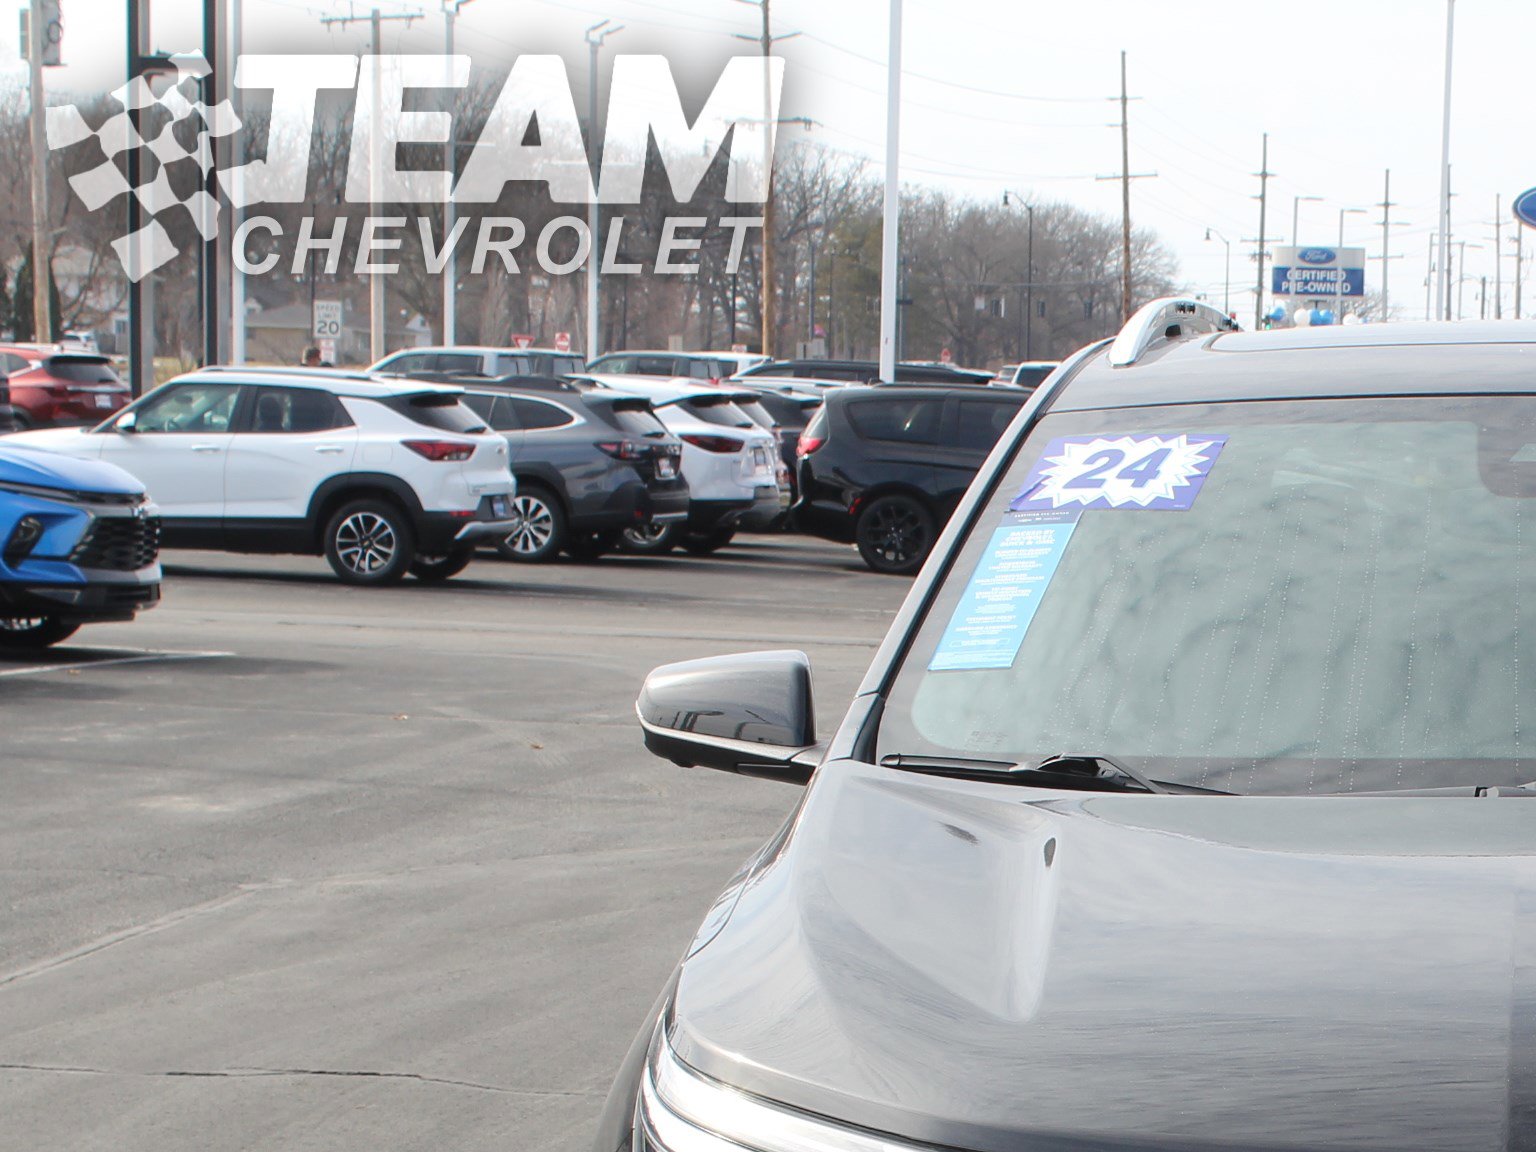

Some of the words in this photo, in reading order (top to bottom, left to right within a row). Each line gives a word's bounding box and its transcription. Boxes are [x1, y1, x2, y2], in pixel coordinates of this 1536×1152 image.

[1281, 281, 1351, 293] PE-OWND
[317, 321, 340, 335] 20
[1062, 447, 1173, 490] 24
